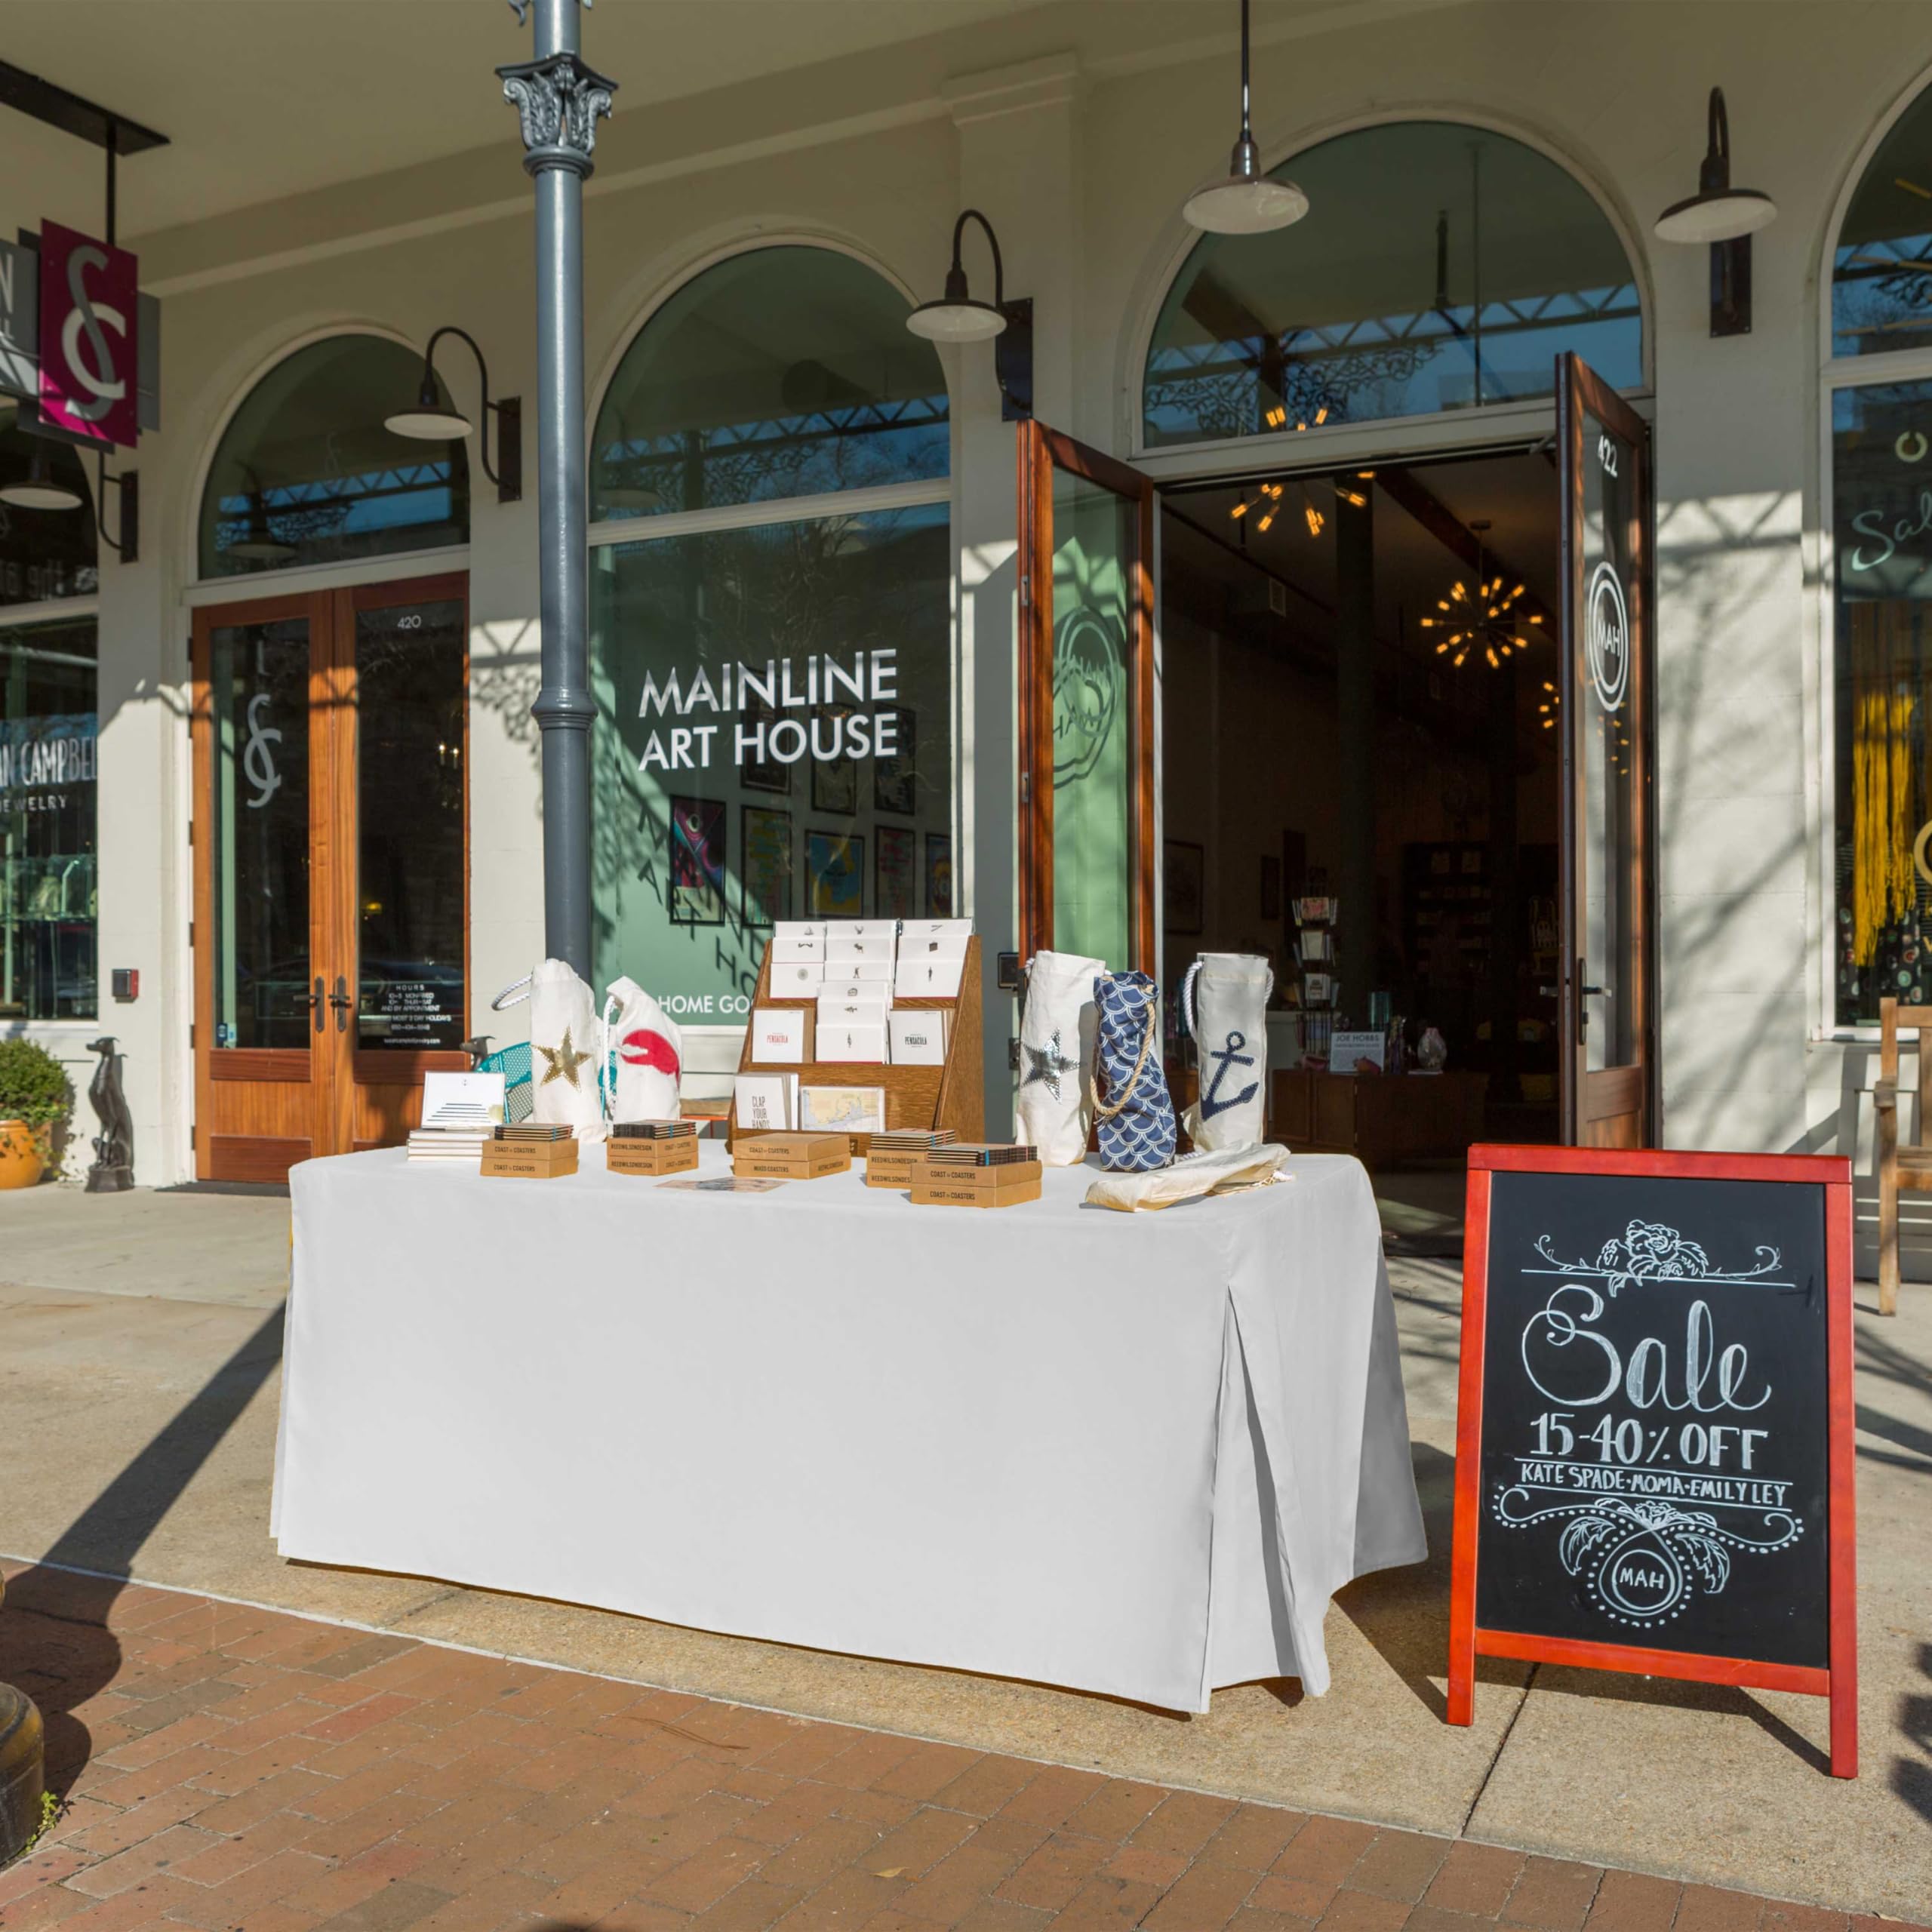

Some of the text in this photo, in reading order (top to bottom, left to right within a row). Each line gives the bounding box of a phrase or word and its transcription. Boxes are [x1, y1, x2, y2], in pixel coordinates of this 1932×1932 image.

[1598, 435, 1617, 478] 422
[397, 615, 421, 629] 420
[1597, 620, 1620, 657] MAH
[638, 648, 897, 718] MAINLINE
[638, 712, 897, 771] ART HOUSE
[658, 995, 753, 1014] HOME GO
[752, 1096, 765, 1107] CLAP
[951, 1171, 976, 1180] COASTERS
[950, 1192, 975, 1200] COASTERS
[1521, 1284, 1772, 1412] Sale
[1530, 1412, 1768, 1469] 15-40% OFF
[1521, 1463, 1564, 1484] KATE
[1752, 1485, 1786, 1506] LEY
[1620, 1567, 1664, 1589] MAH
